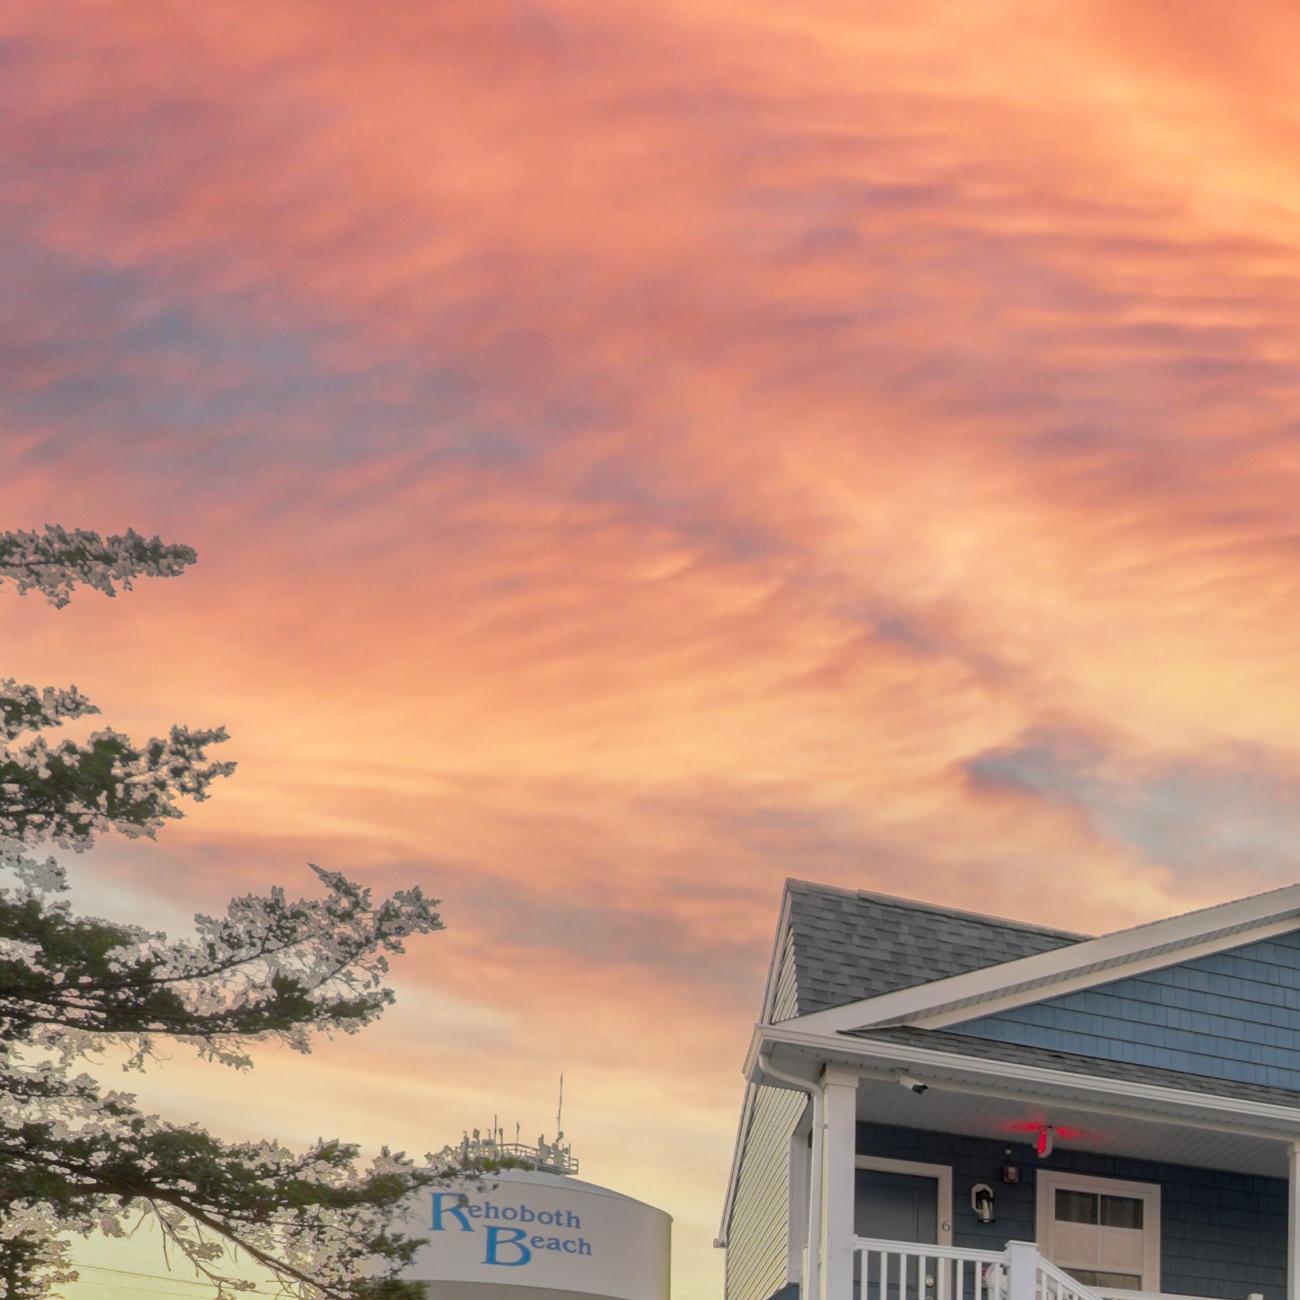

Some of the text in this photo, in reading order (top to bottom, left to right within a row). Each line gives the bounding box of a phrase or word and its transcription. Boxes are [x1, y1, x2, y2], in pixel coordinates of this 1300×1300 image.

[429, 1192, 581, 1232] Rehoboth
[941, 1220, 951, 1232] 6
[480, 1224, 592, 1267] Beach
